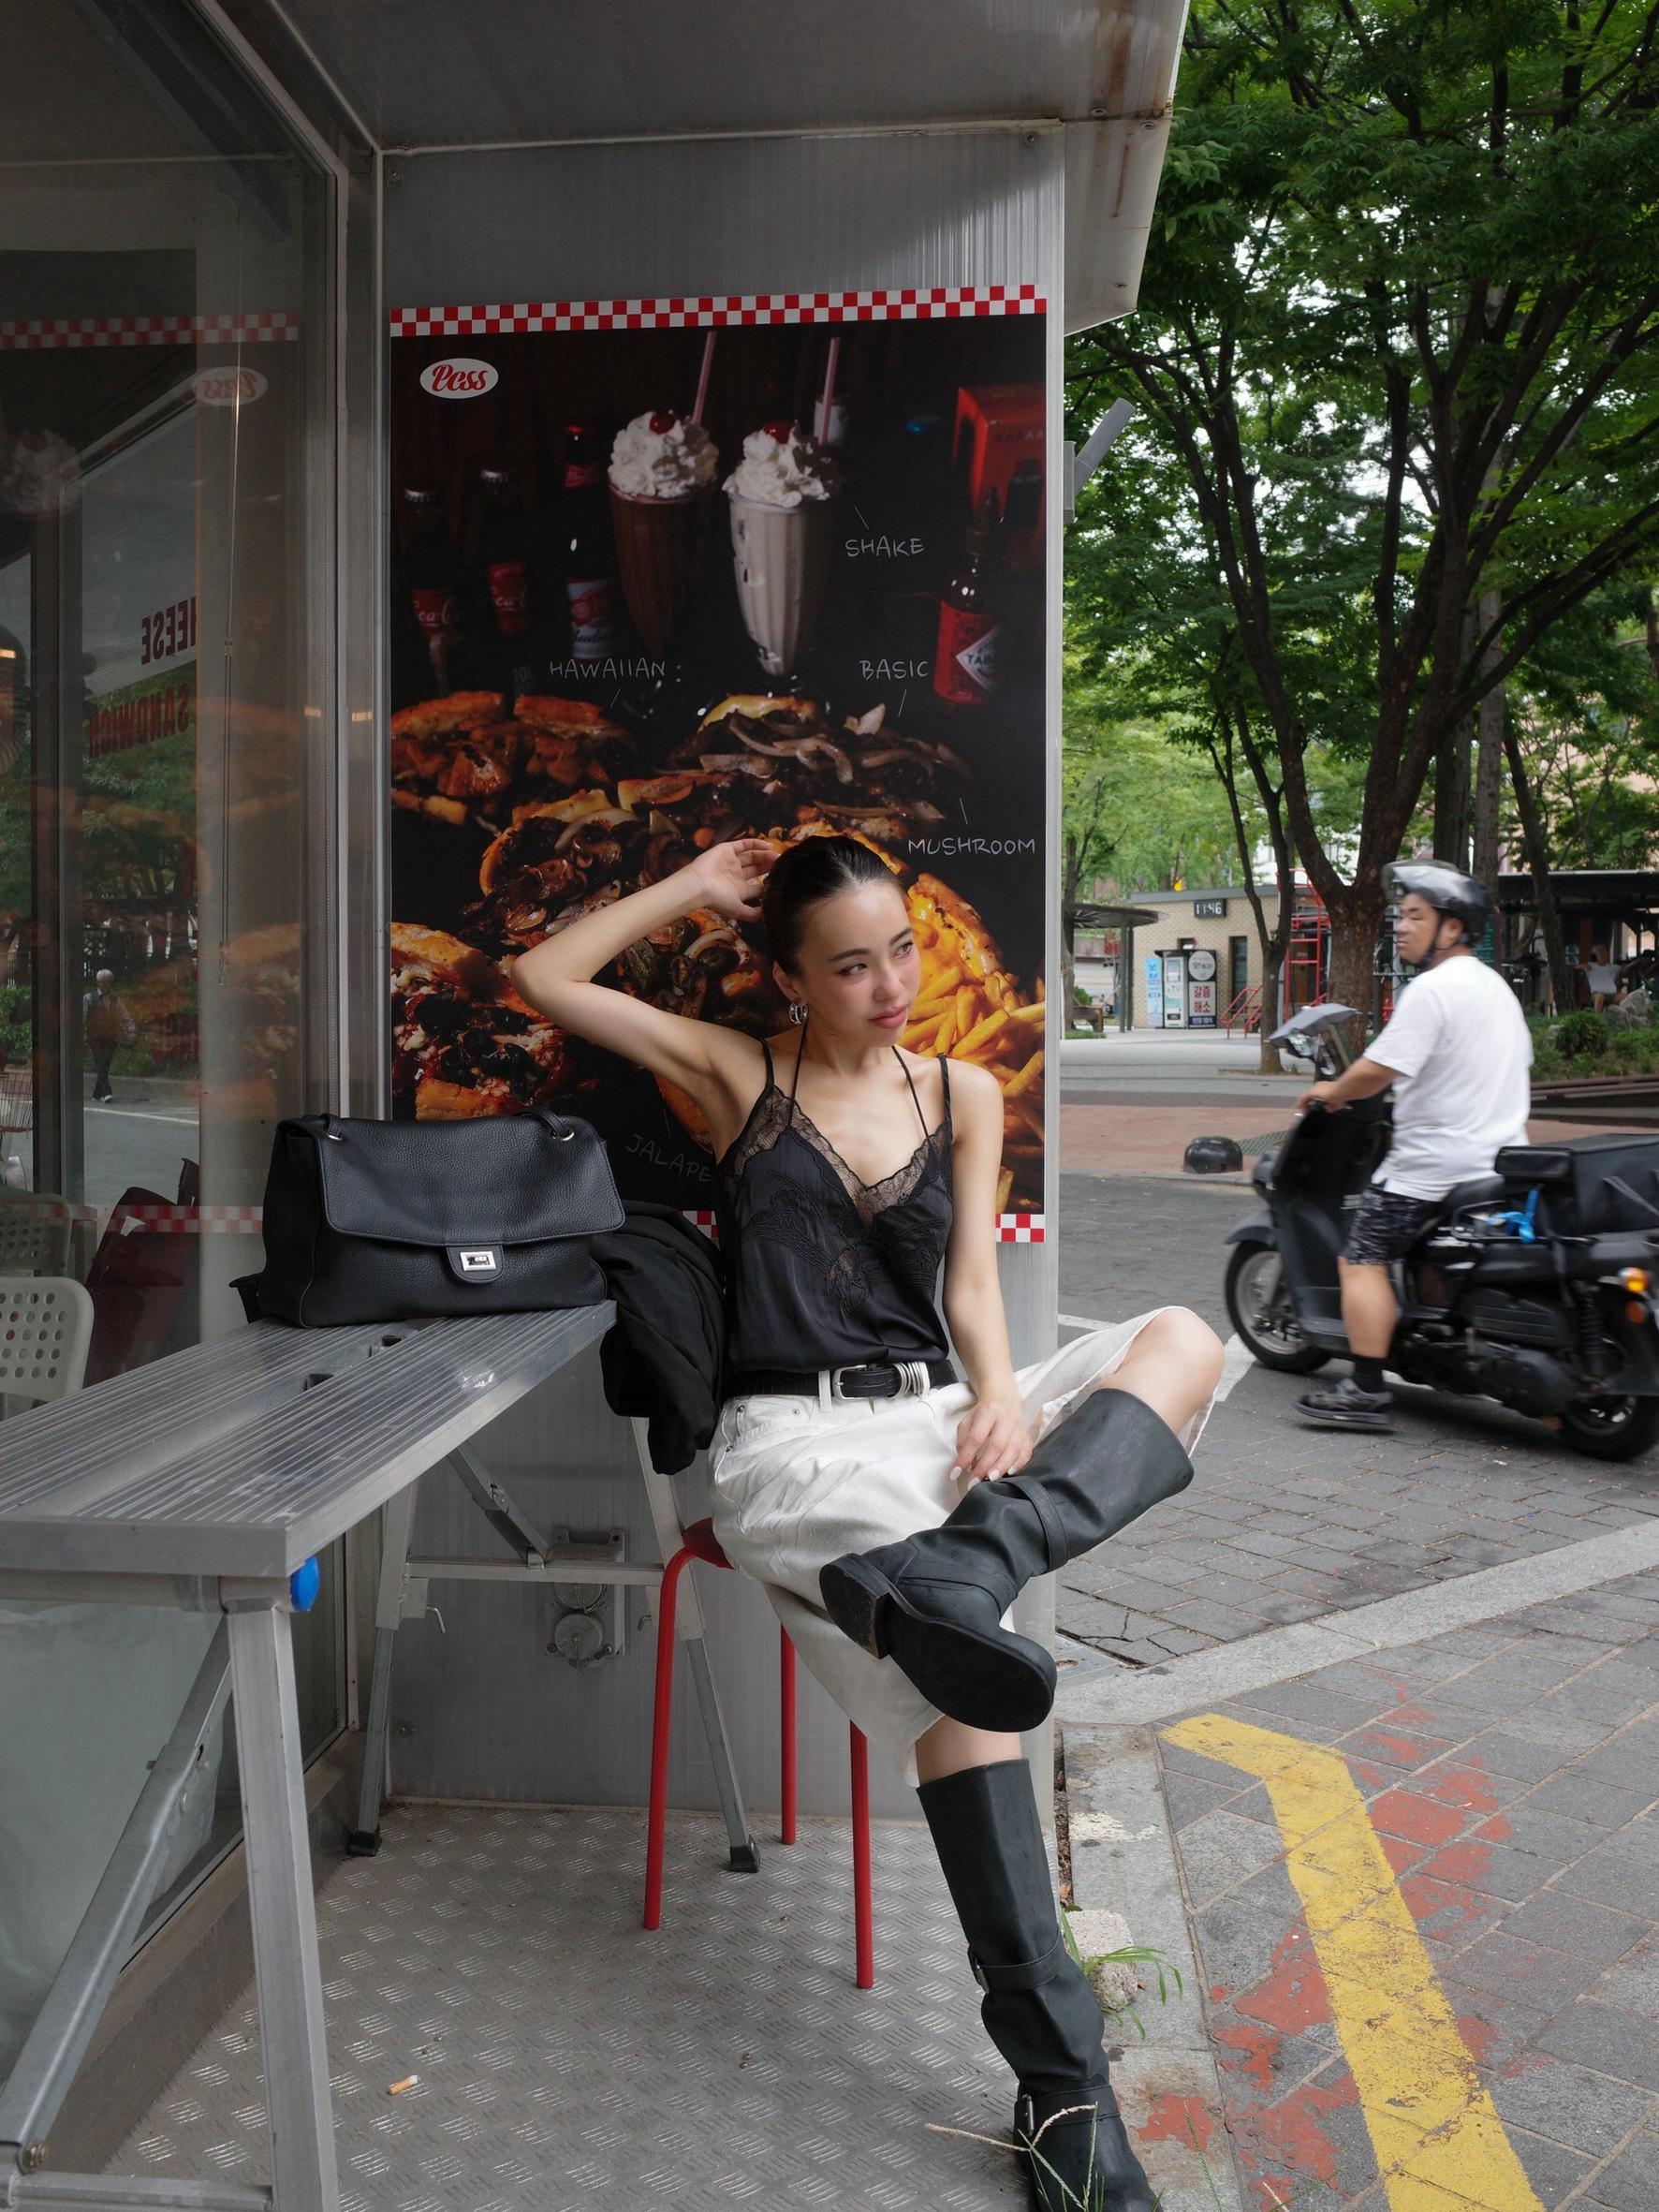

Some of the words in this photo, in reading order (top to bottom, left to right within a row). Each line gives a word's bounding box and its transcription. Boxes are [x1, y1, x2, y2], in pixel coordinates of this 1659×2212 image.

[432, 363, 489, 391] Pess
[844, 535, 926, 559] SHAKE
[550, 656, 667, 680] HAWAIIAN
[859, 657, 929, 681] BASIC
[907, 836, 1035, 856] MUSHROOM
[1196, 902, 1223, 916] 11:46
